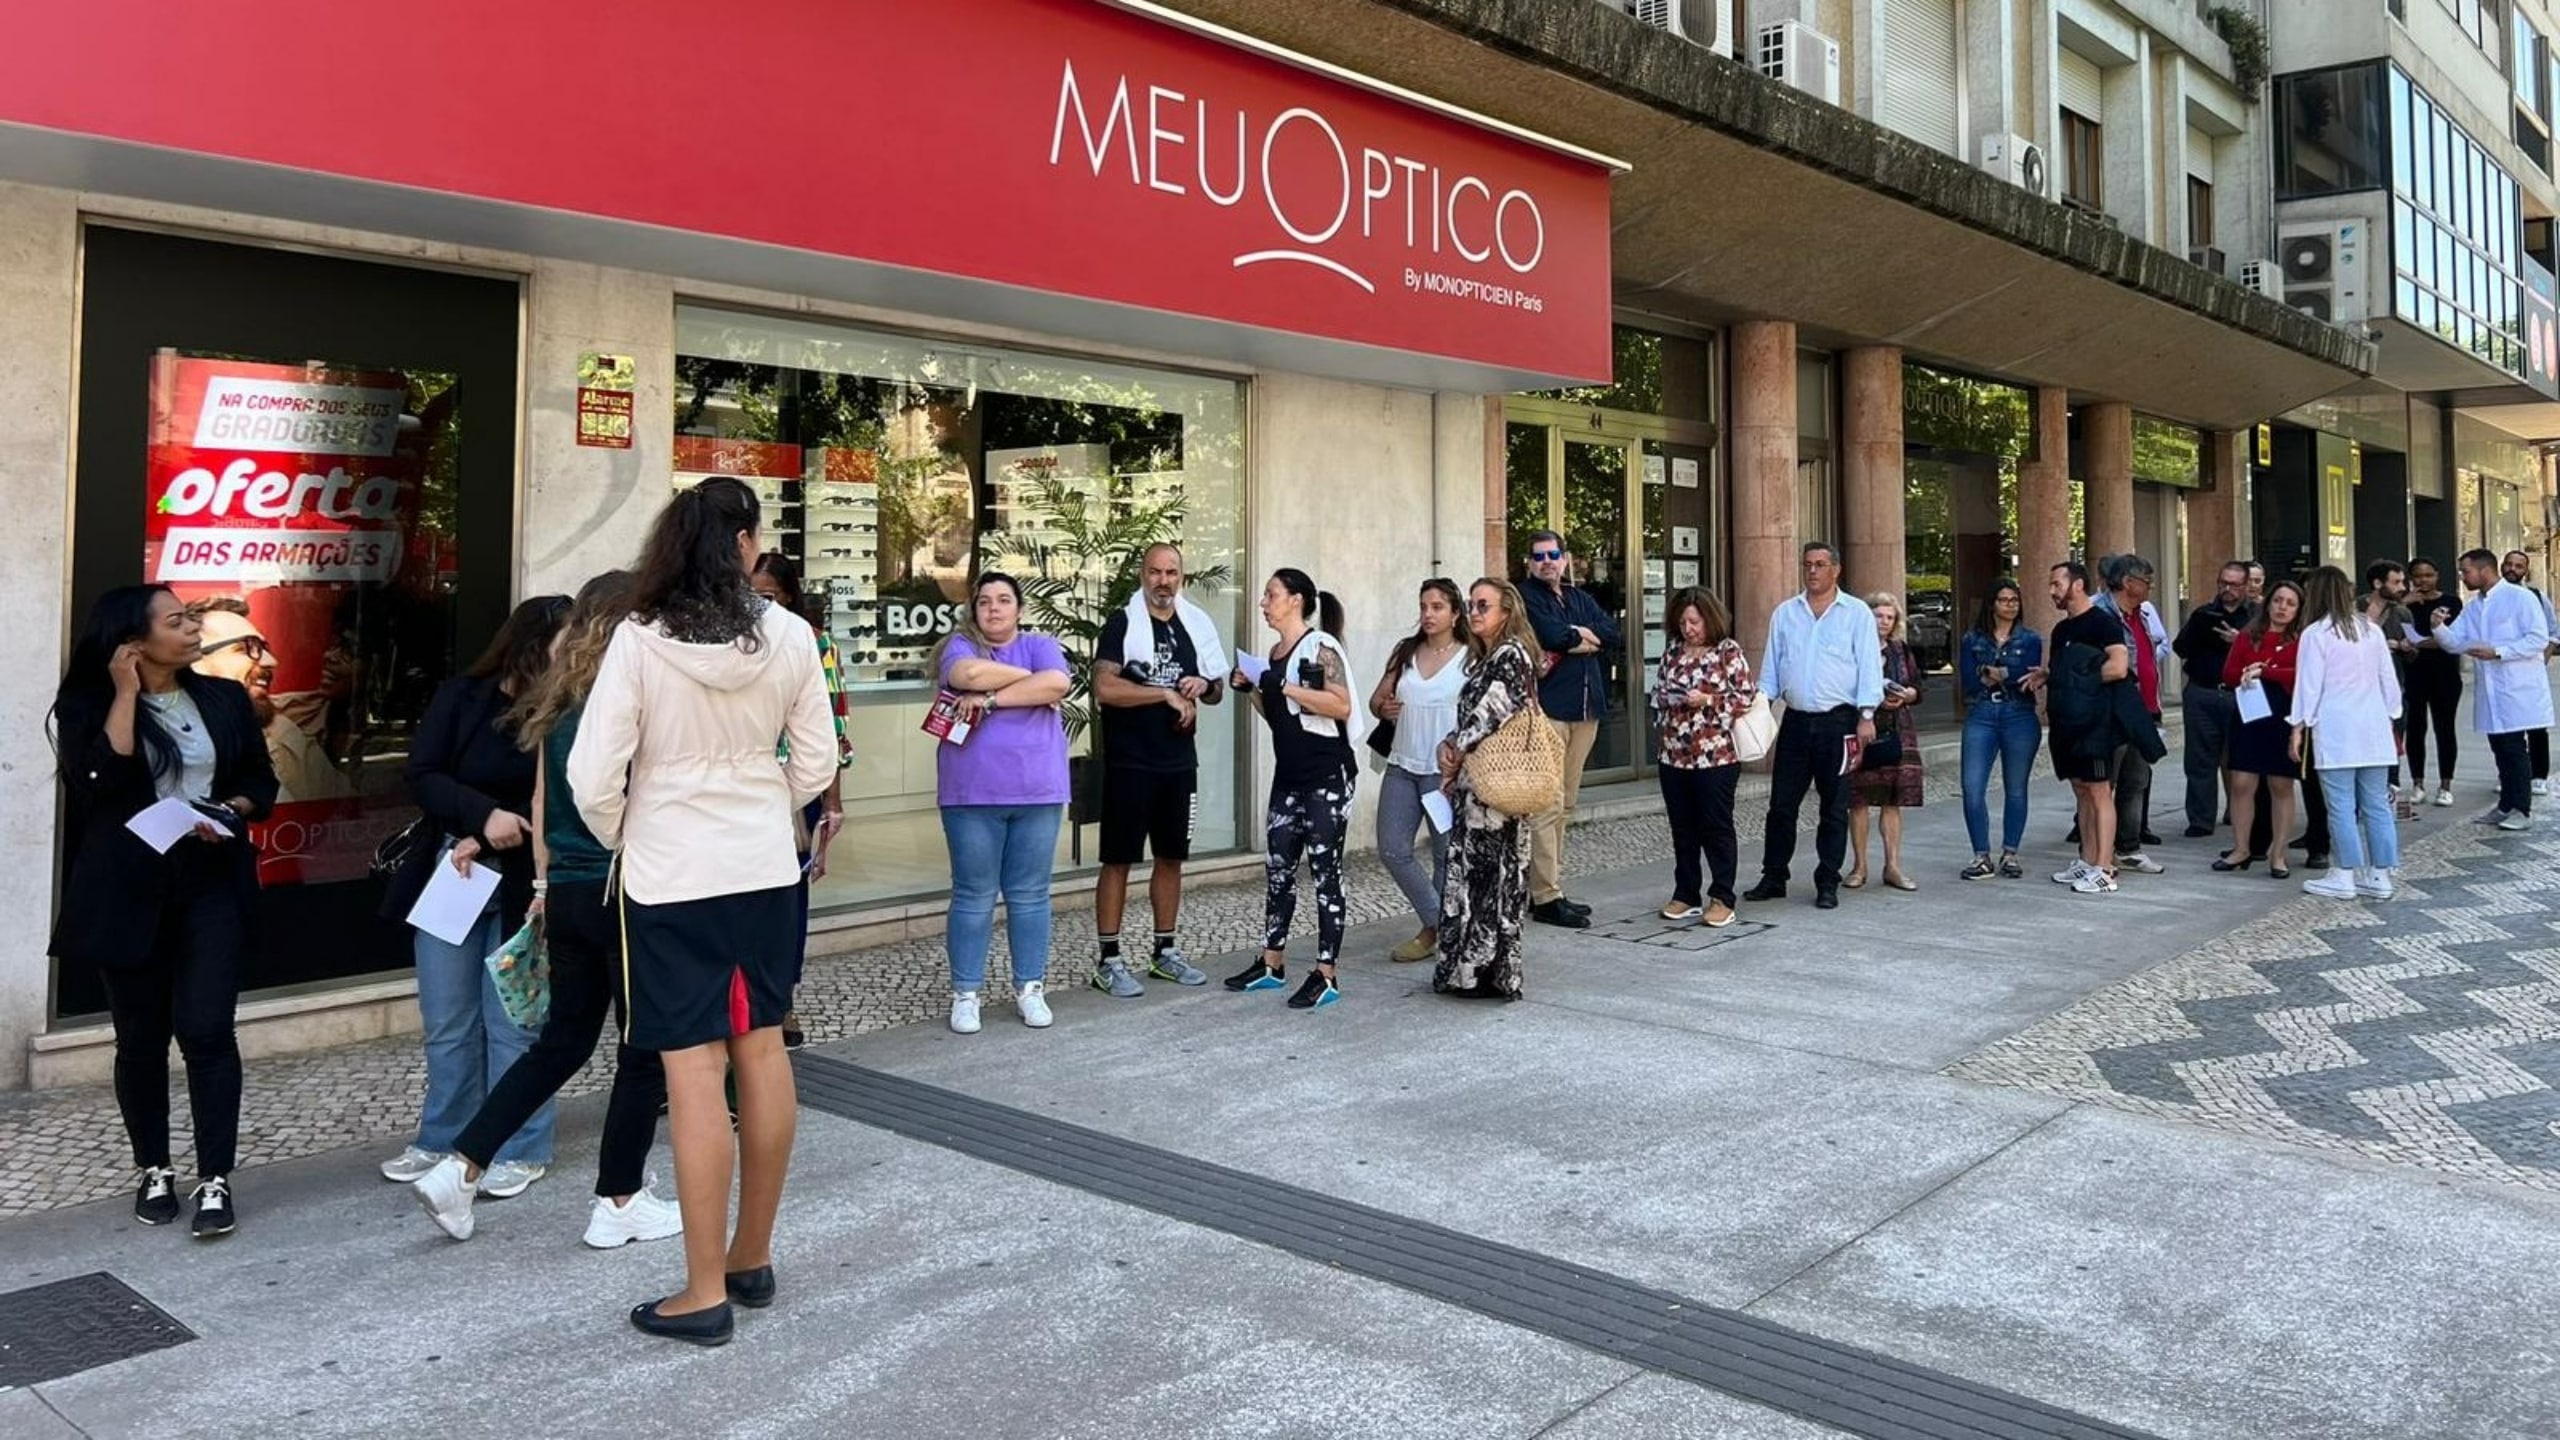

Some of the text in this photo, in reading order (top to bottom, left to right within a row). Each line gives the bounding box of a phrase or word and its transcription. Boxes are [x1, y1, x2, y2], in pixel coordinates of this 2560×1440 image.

[1404, 268, 1543, 313] By MONOPTICIEN Paris
[218, 393, 392, 418] NA COMPRA DOS SEUS
[581, 391, 630, 408] Alarme
[164, 457, 400, 520] oferta
[173, 541, 382, 573] DAS ARMAÇÕES
